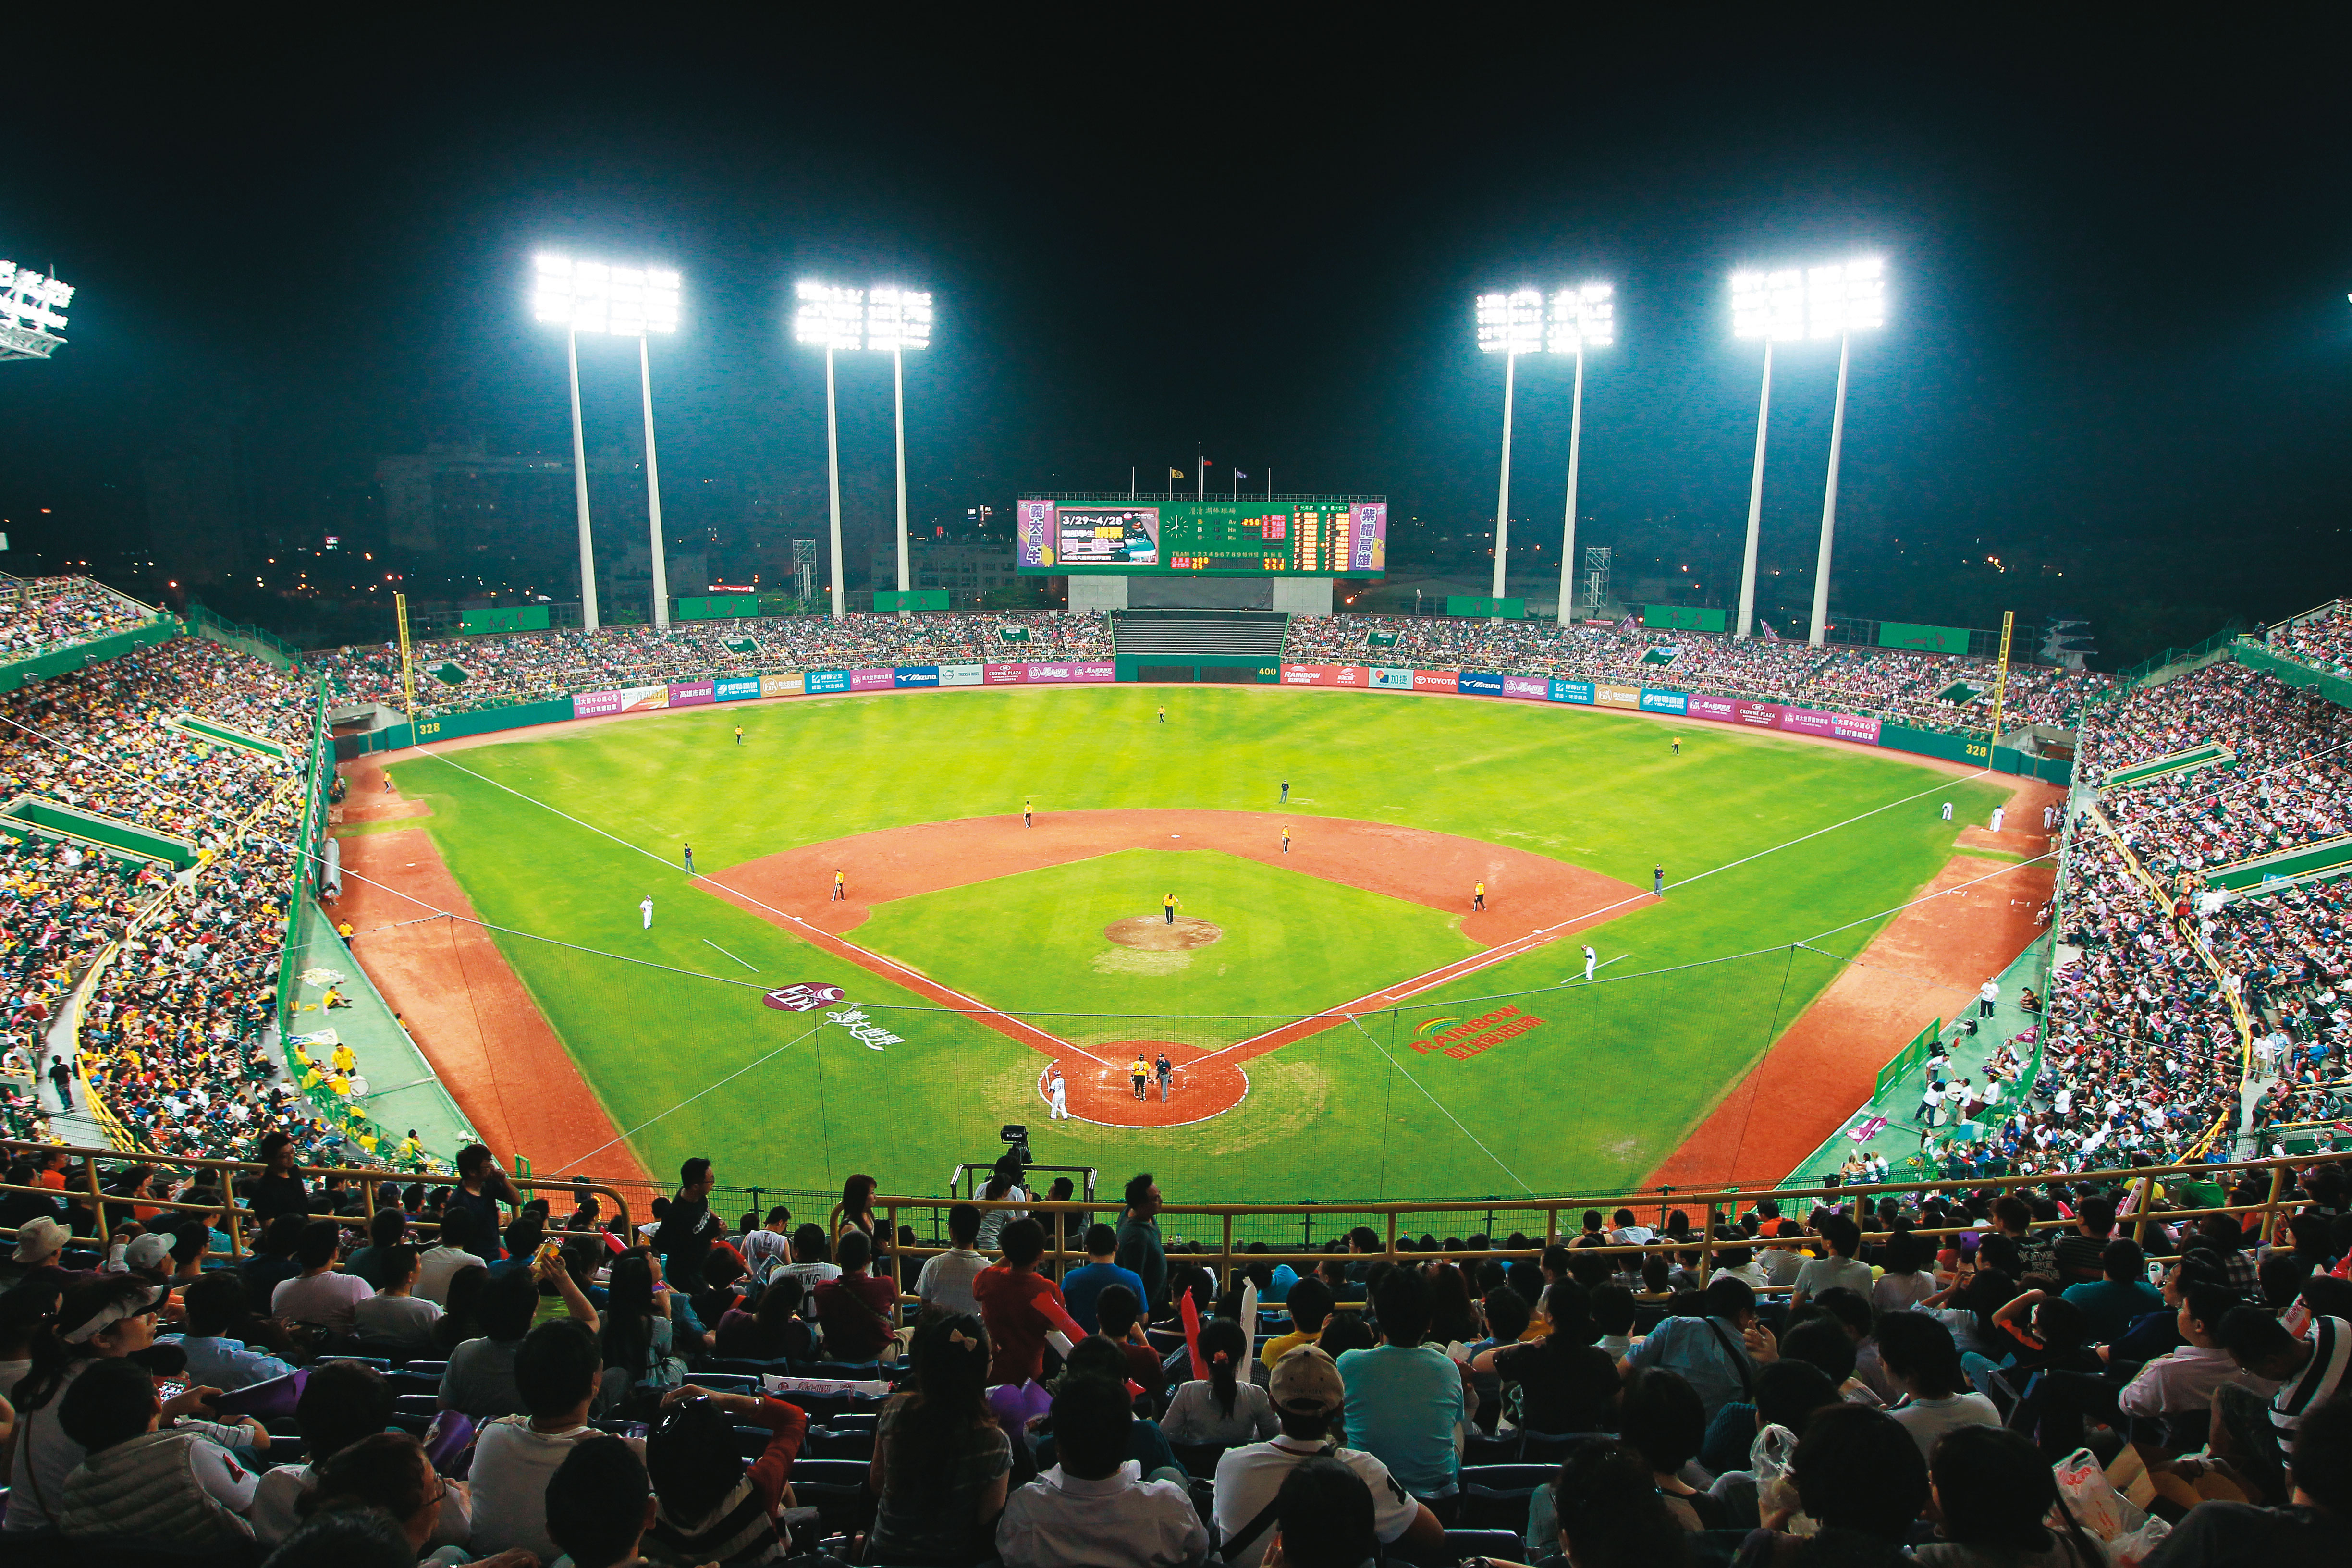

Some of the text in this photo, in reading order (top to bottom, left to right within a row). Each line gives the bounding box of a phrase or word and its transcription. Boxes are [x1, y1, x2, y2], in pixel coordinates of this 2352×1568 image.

[1062, 516, 1124, 526] 3/29~4/28
[1026, 504, 1045, 564] 義大犀牛
[1355, 507, 1377, 567] 紫耀高雄
[1391, 674, 1408, 685] 加捷
[679, 688, 712, 698] 高雄市政府
[419, 722, 441, 735] 328
[1965, 744, 1988, 757] 328
[1409, 1004, 1522, 1055] RAINBOW
